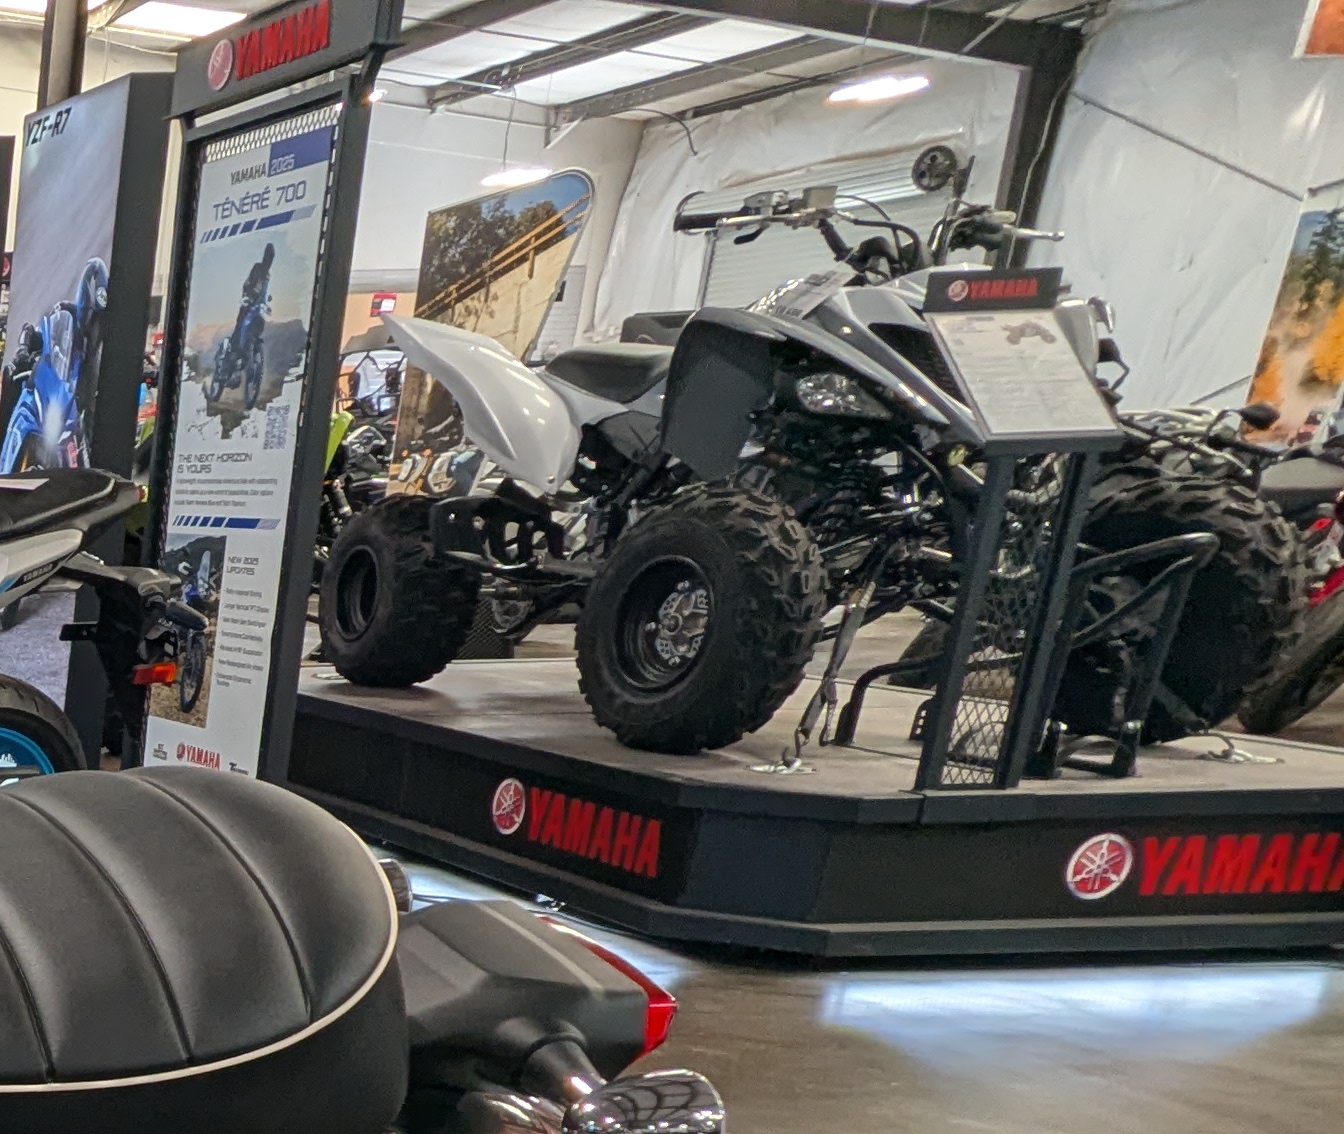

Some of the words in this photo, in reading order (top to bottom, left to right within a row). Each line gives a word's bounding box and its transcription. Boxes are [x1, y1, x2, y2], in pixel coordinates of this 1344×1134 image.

[237, 0, 331, 81] YAMAHA
[25, 106, 72, 147] YZF-R7
[230, 162, 267, 185] YAMAHA
[271, 153, 295, 174] 2025
[276, 180, 307, 206] 700
[968, 278, 1038, 300] YAMAHA
[178, 453, 193, 463] THE
[194, 453, 215, 463] NEXT
[216, 452, 253, 463] HORIZON
[186, 464, 212, 474] YOURS
[186, 744, 221, 770] YAMAHA
[528, 786, 661, 879] YAMAHA
[1139, 832, 1344, 896] YAMAH
